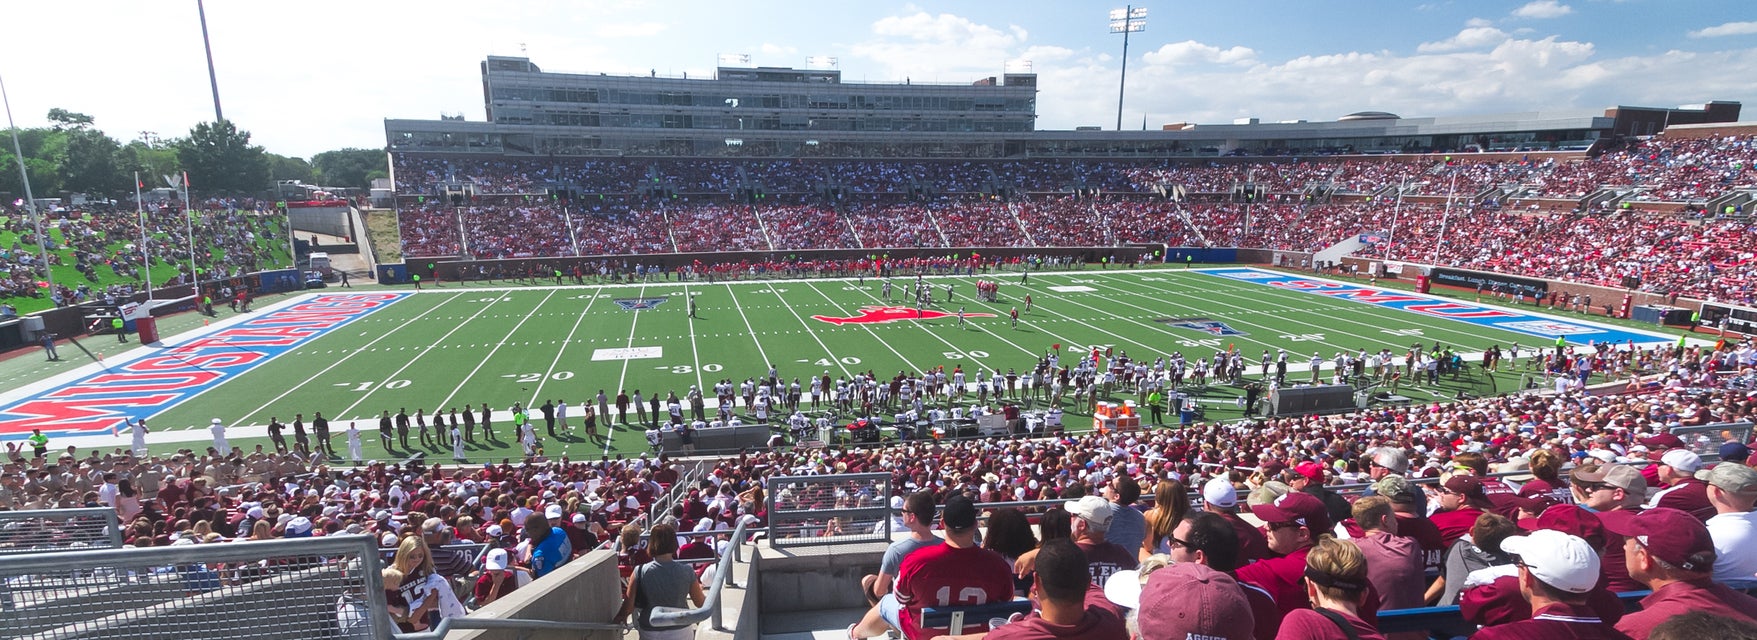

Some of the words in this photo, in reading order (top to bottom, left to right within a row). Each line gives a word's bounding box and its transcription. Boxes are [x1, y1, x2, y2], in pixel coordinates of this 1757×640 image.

[1266, 281, 1526, 319] SMU
[942, 350, 990, 360] 50
[0, 293, 403, 435] MUSTANGS
[814, 356, 862, 367] 40
[672, 363, 724, 374] 30
[516, 371, 575, 383] 20
[350, 379, 412, 392] 10
[453, 549, 473, 565] 26
